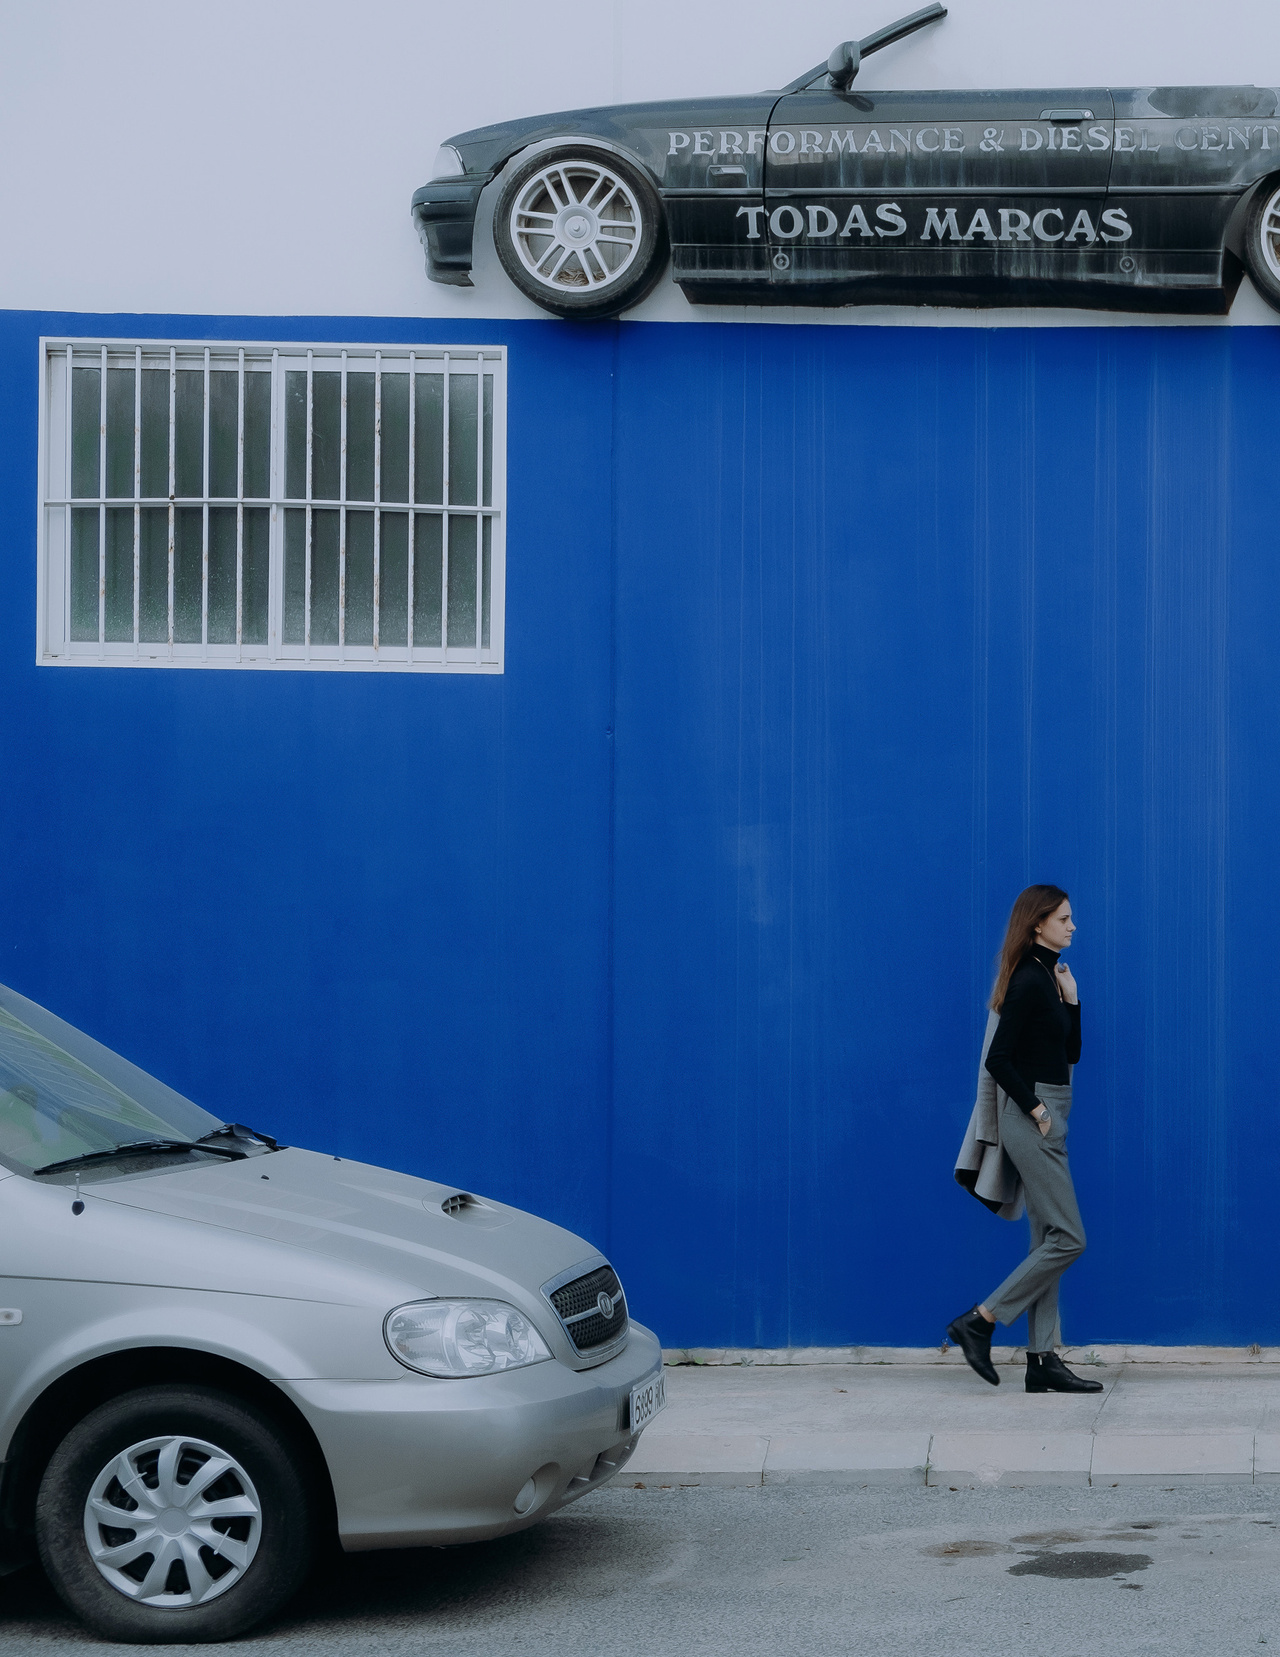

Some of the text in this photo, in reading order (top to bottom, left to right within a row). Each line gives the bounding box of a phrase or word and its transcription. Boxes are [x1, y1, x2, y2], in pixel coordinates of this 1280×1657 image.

[667, 126, 966, 157] PERFORMANCE
[979, 126, 1004, 153] &
[1019, 125, 1161, 153] DIESEL
[735, 202, 1133, 243] TODAS MARCAS
